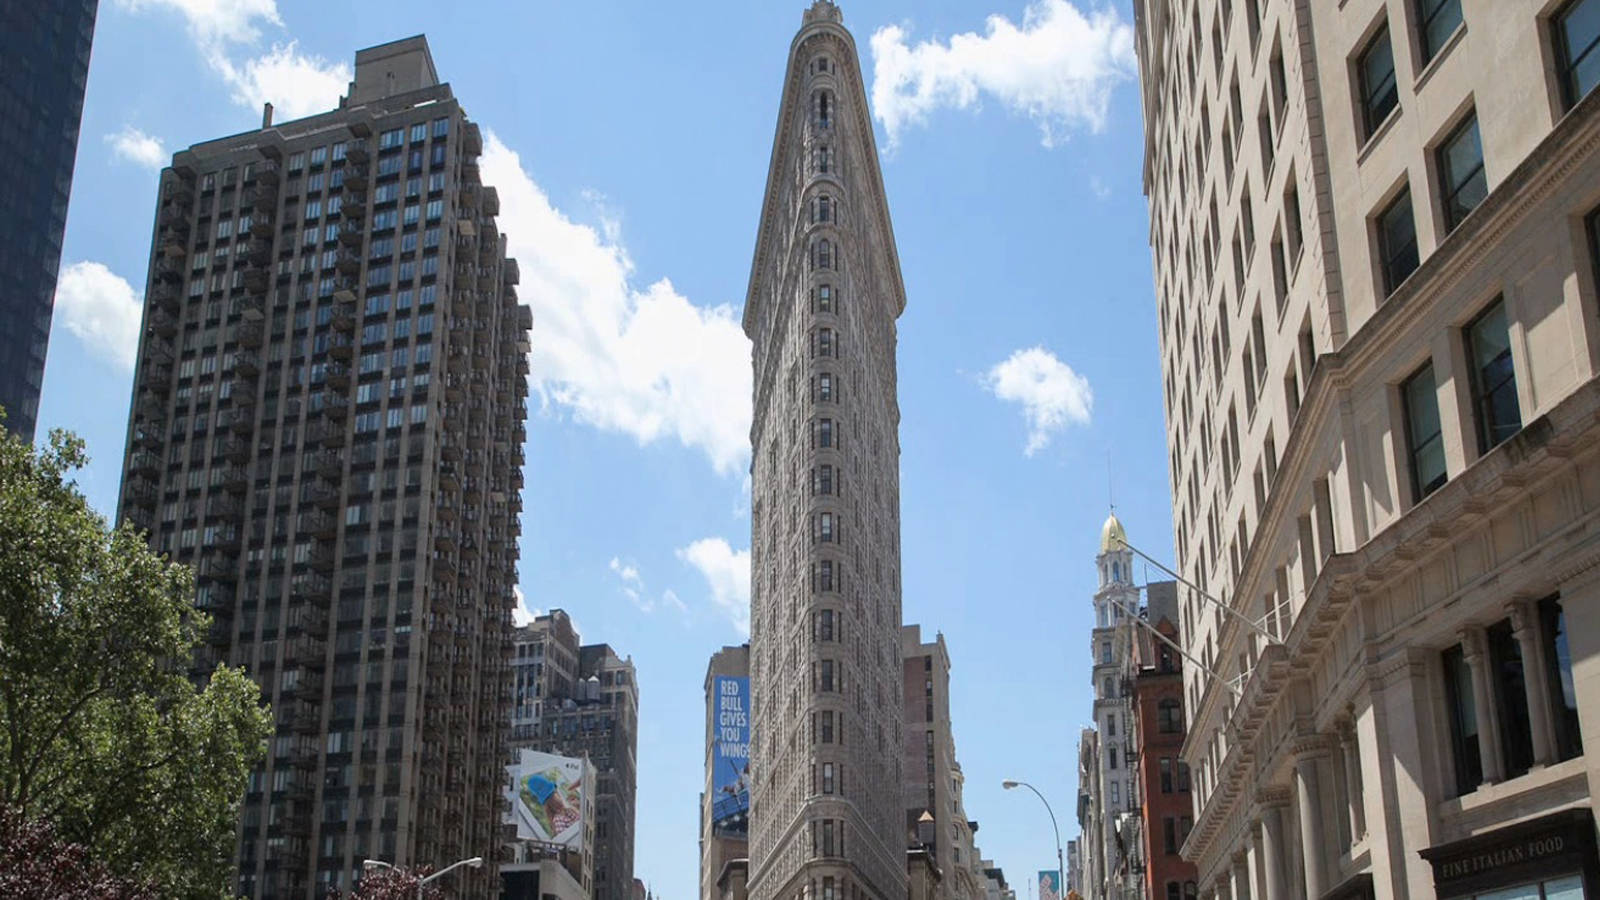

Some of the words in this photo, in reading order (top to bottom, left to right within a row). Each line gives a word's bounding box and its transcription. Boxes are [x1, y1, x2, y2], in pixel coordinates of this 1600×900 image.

[721, 680, 739, 695] RED
[721, 696, 742, 711] BULL
[720, 712, 746, 727] GIVES
[720, 727, 740, 742] YOU
[1442, 859, 1470, 878] FINE
[1474, 847, 1524, 871] ITALIAN
[1529, 836, 1564, 856] FOOD
